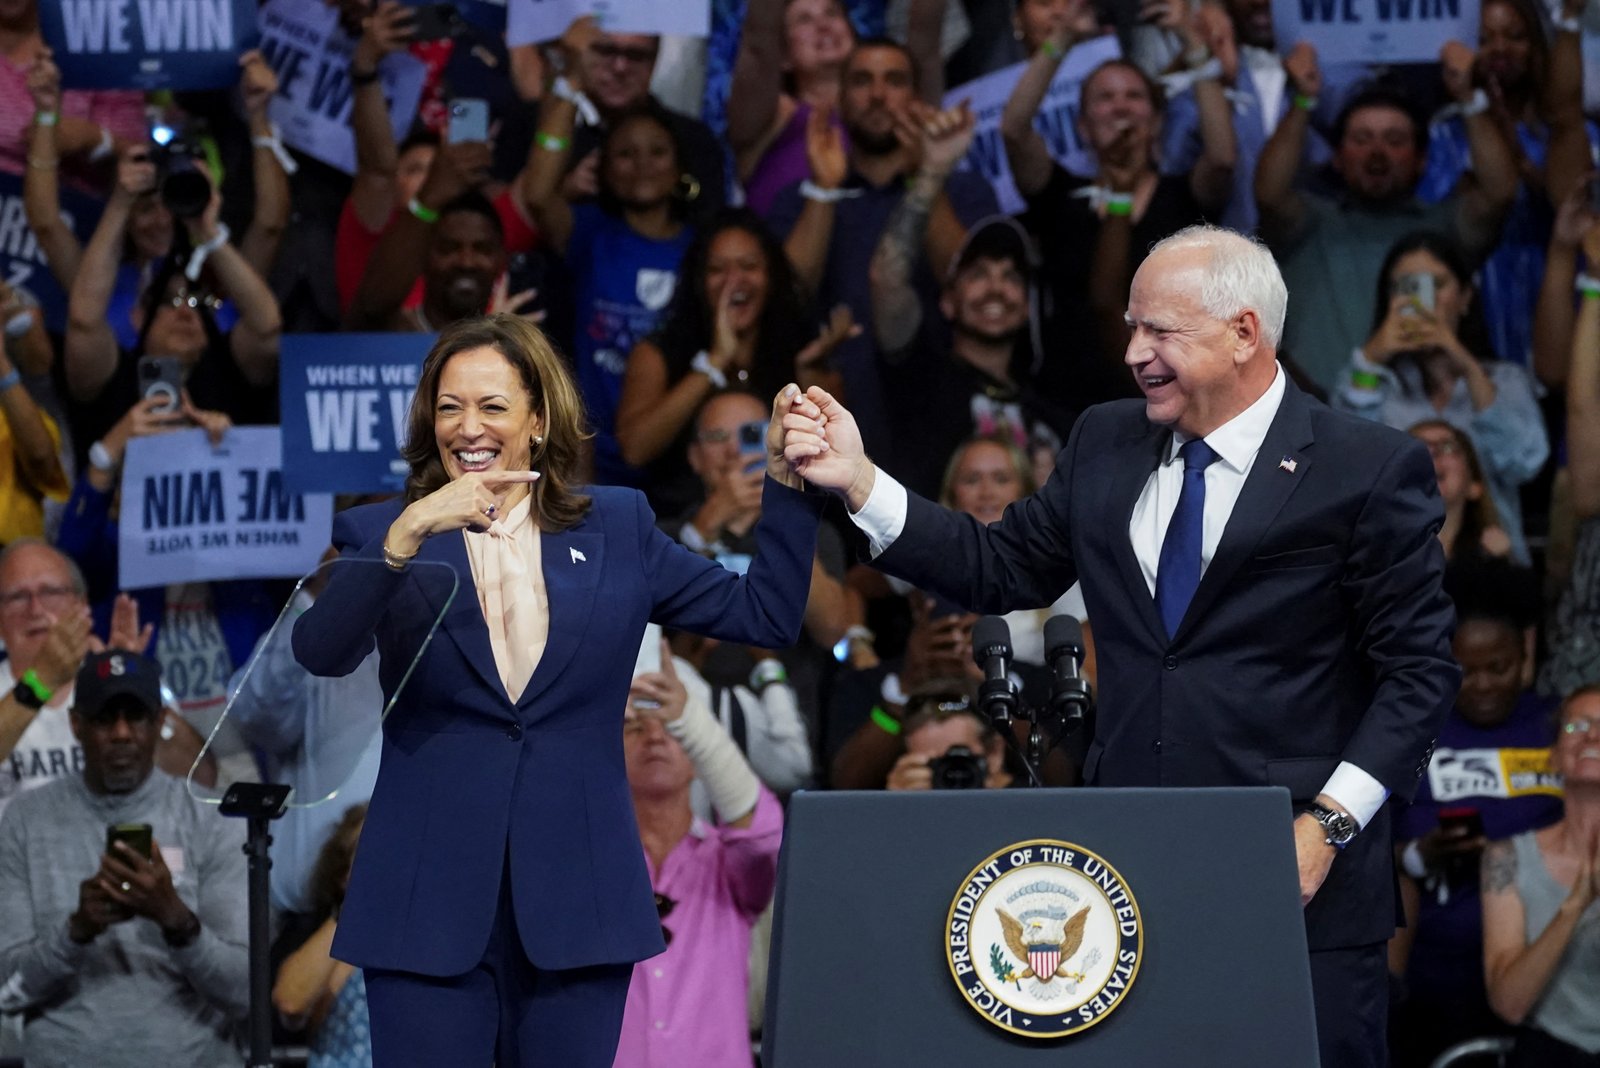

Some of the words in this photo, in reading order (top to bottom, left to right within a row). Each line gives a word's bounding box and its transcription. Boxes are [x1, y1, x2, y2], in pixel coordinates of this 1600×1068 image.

[60, 0, 131, 54] WE
[136, 0, 235, 52] WIN
[306, 364, 377, 387] WHEN
[380, 364, 417, 386] WE
[305, 389, 381, 452] WE
[143, 471, 225, 529] WIN
[237, 468, 306, 523] WE
[147, 533, 192, 555] VOTE
[202, 530, 230, 547] WE
[236, 526, 299, 547] WHEN
[167, 650, 231, 698] 024
[1010, 849, 1032, 867] OF
[1040, 848, 1075, 867] THE
[951, 859, 1001, 976] PRESIDENT
[1083, 856, 1137, 937] UNITED
[968, 980, 1012, 1027] VICE
[1079, 949, 1136, 1022] STATES
